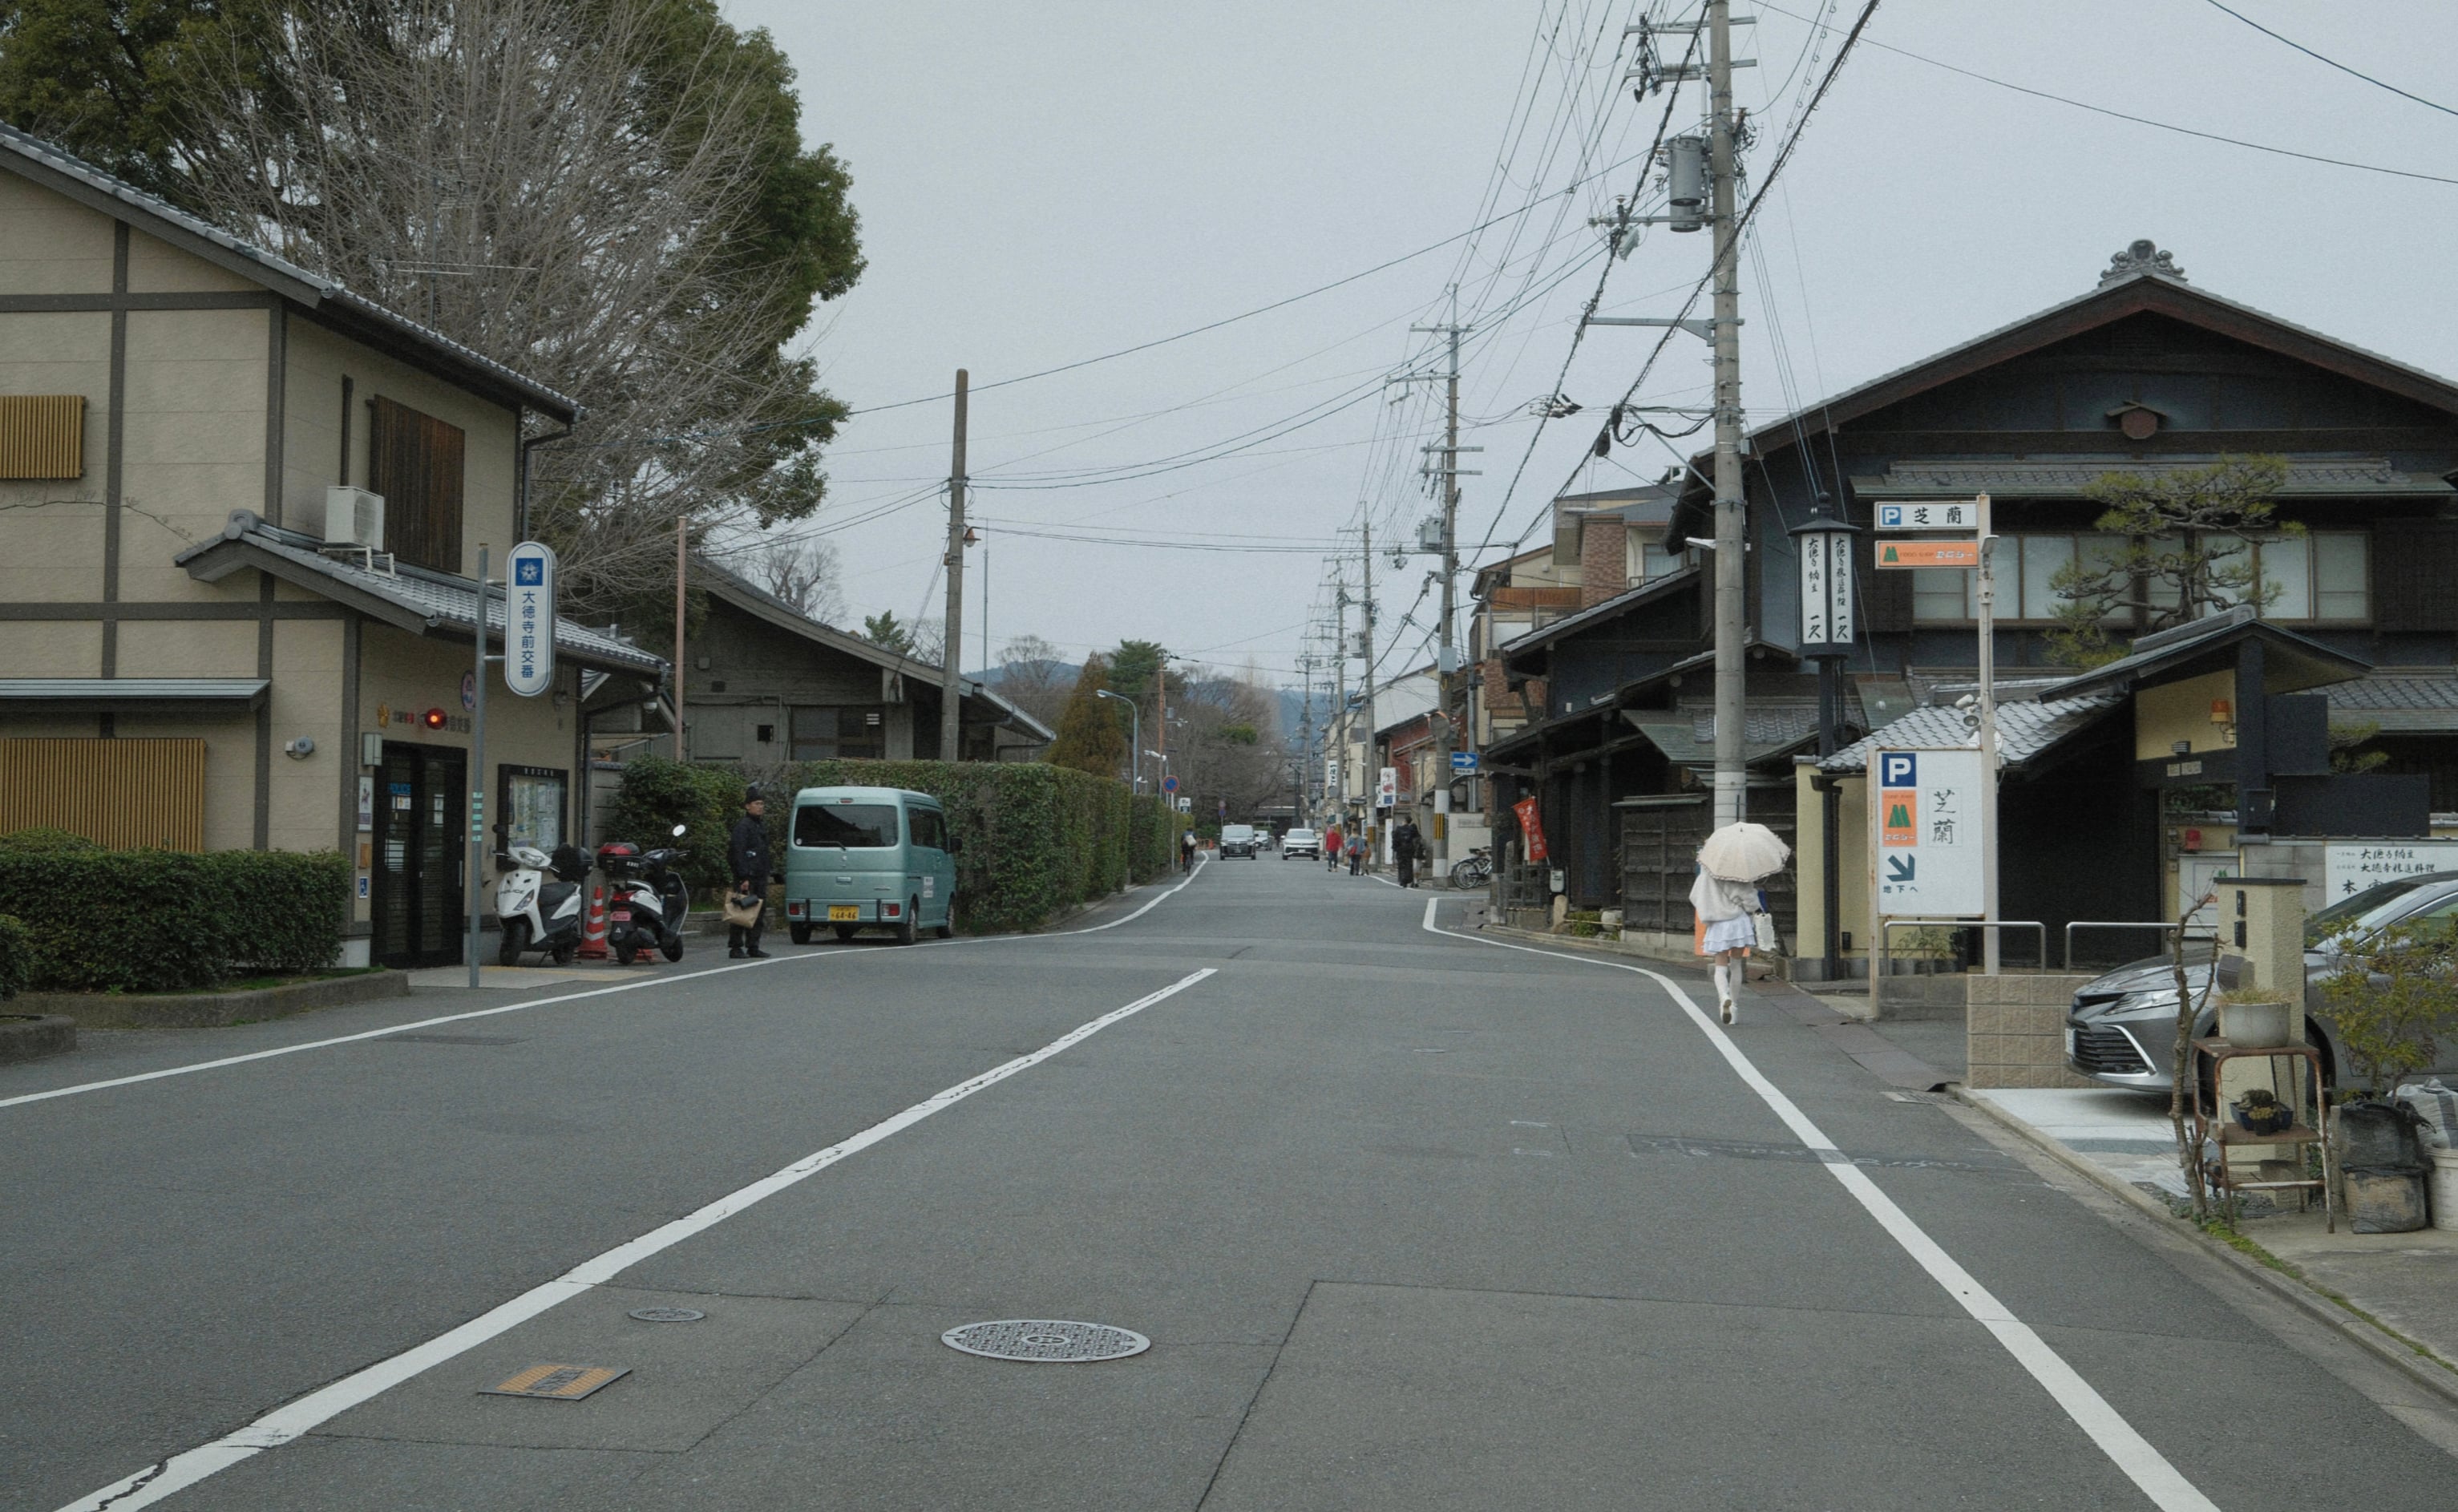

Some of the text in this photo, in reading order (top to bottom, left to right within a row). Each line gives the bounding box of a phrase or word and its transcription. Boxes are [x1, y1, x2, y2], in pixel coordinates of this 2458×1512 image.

[1885, 508, 1899, 524] P
[521, 591, 536, 678] 大徳寺前交番
[1809, 615, 1821, 638] 一久
[1836, 615, 1847, 638] 一久
[1889, 758, 1911, 782] P
[1883, 885, 1918, 894] 地下へ
